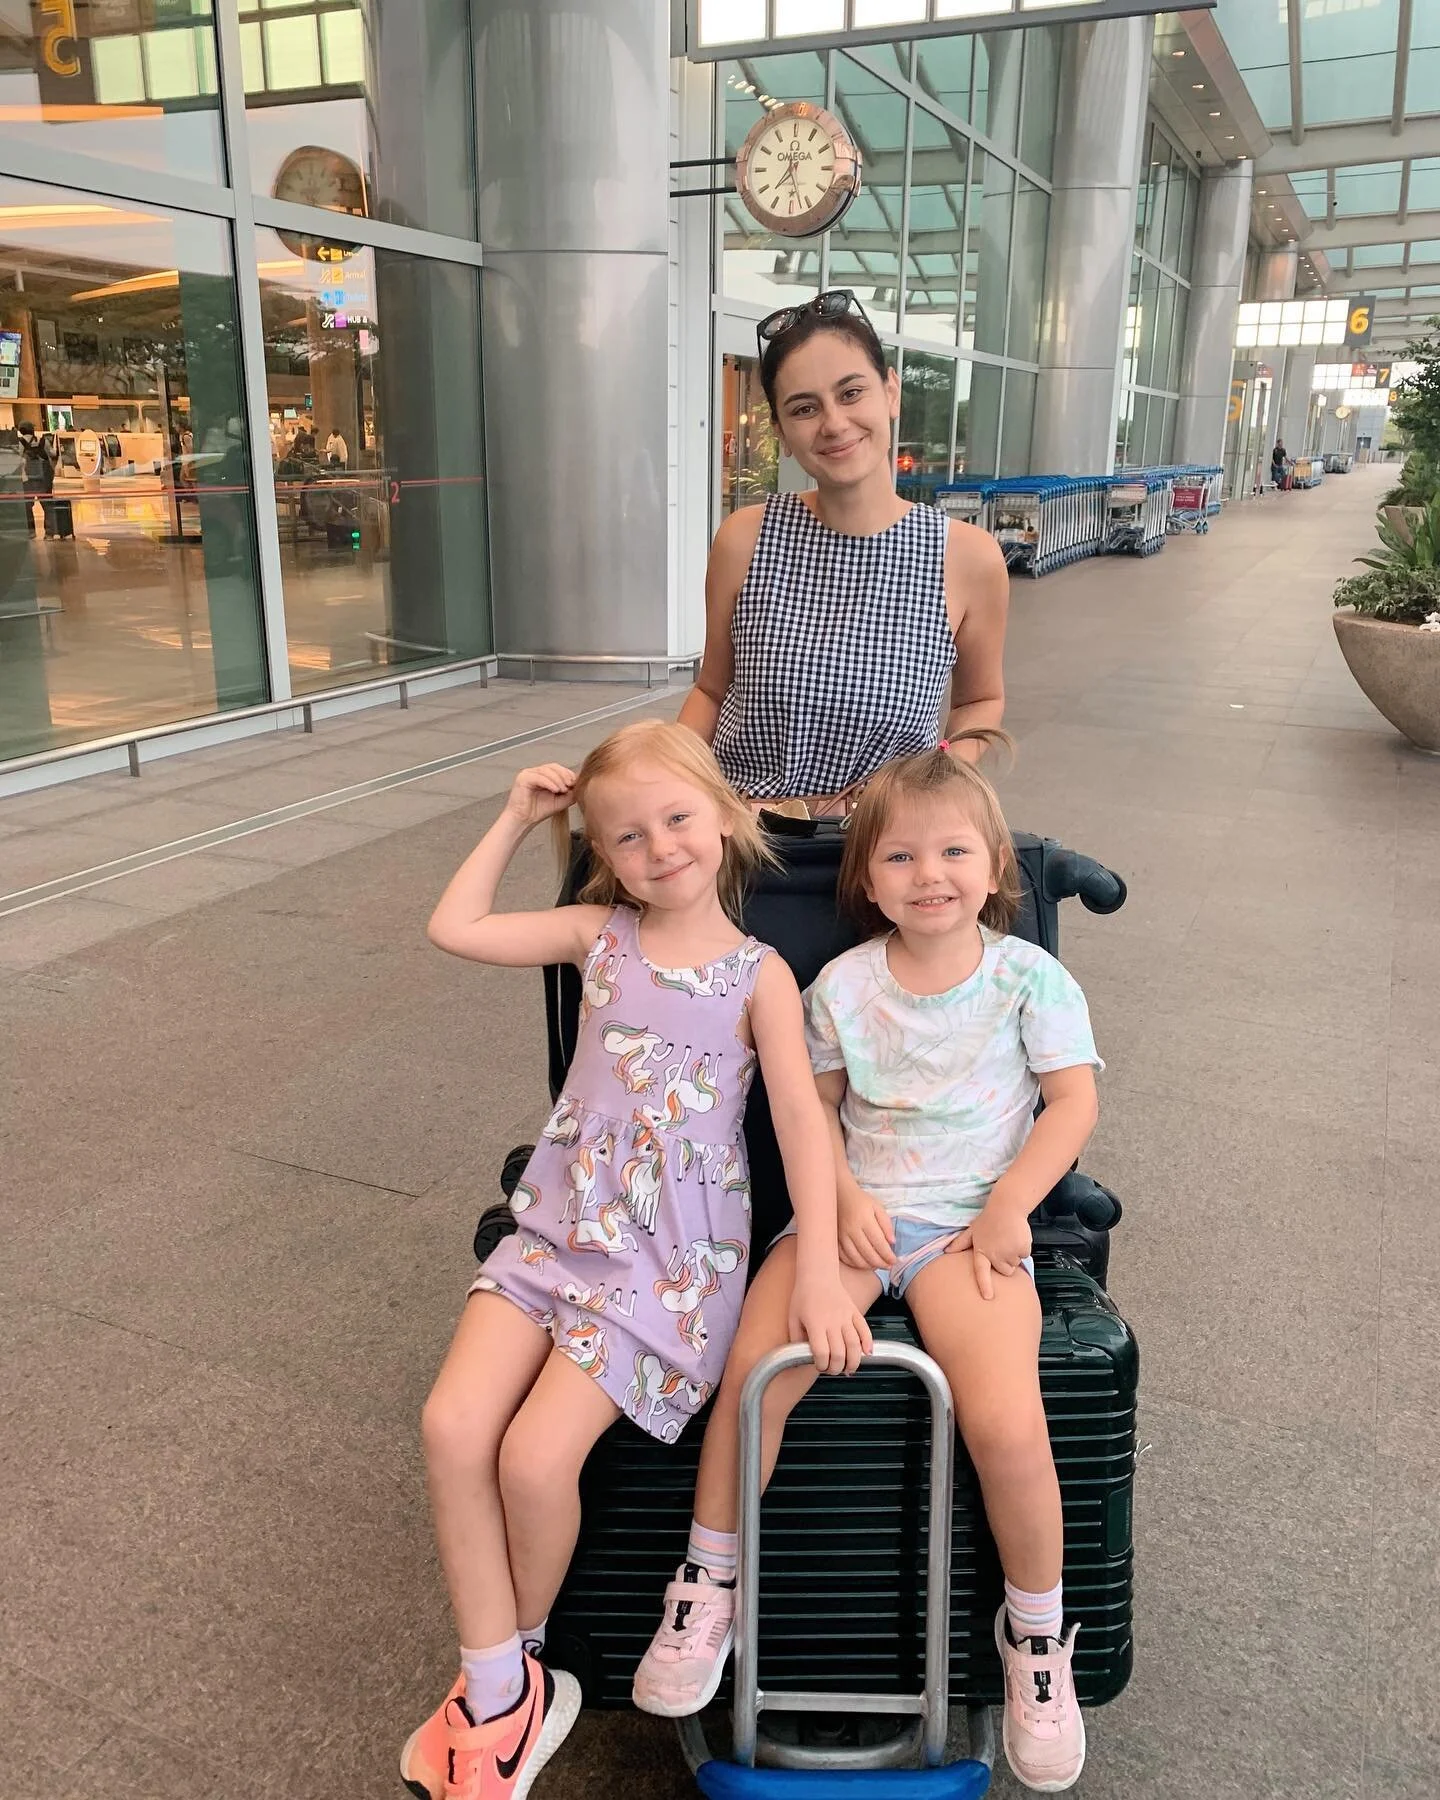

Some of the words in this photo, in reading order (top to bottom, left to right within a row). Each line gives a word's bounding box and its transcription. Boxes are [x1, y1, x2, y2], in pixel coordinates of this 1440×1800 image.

[777, 151, 813, 161] OMEGA
[1350, 307, 1369, 334] 6
[1379, 368, 1390, 384] 7
[1389, 391, 1398, 402] 8
